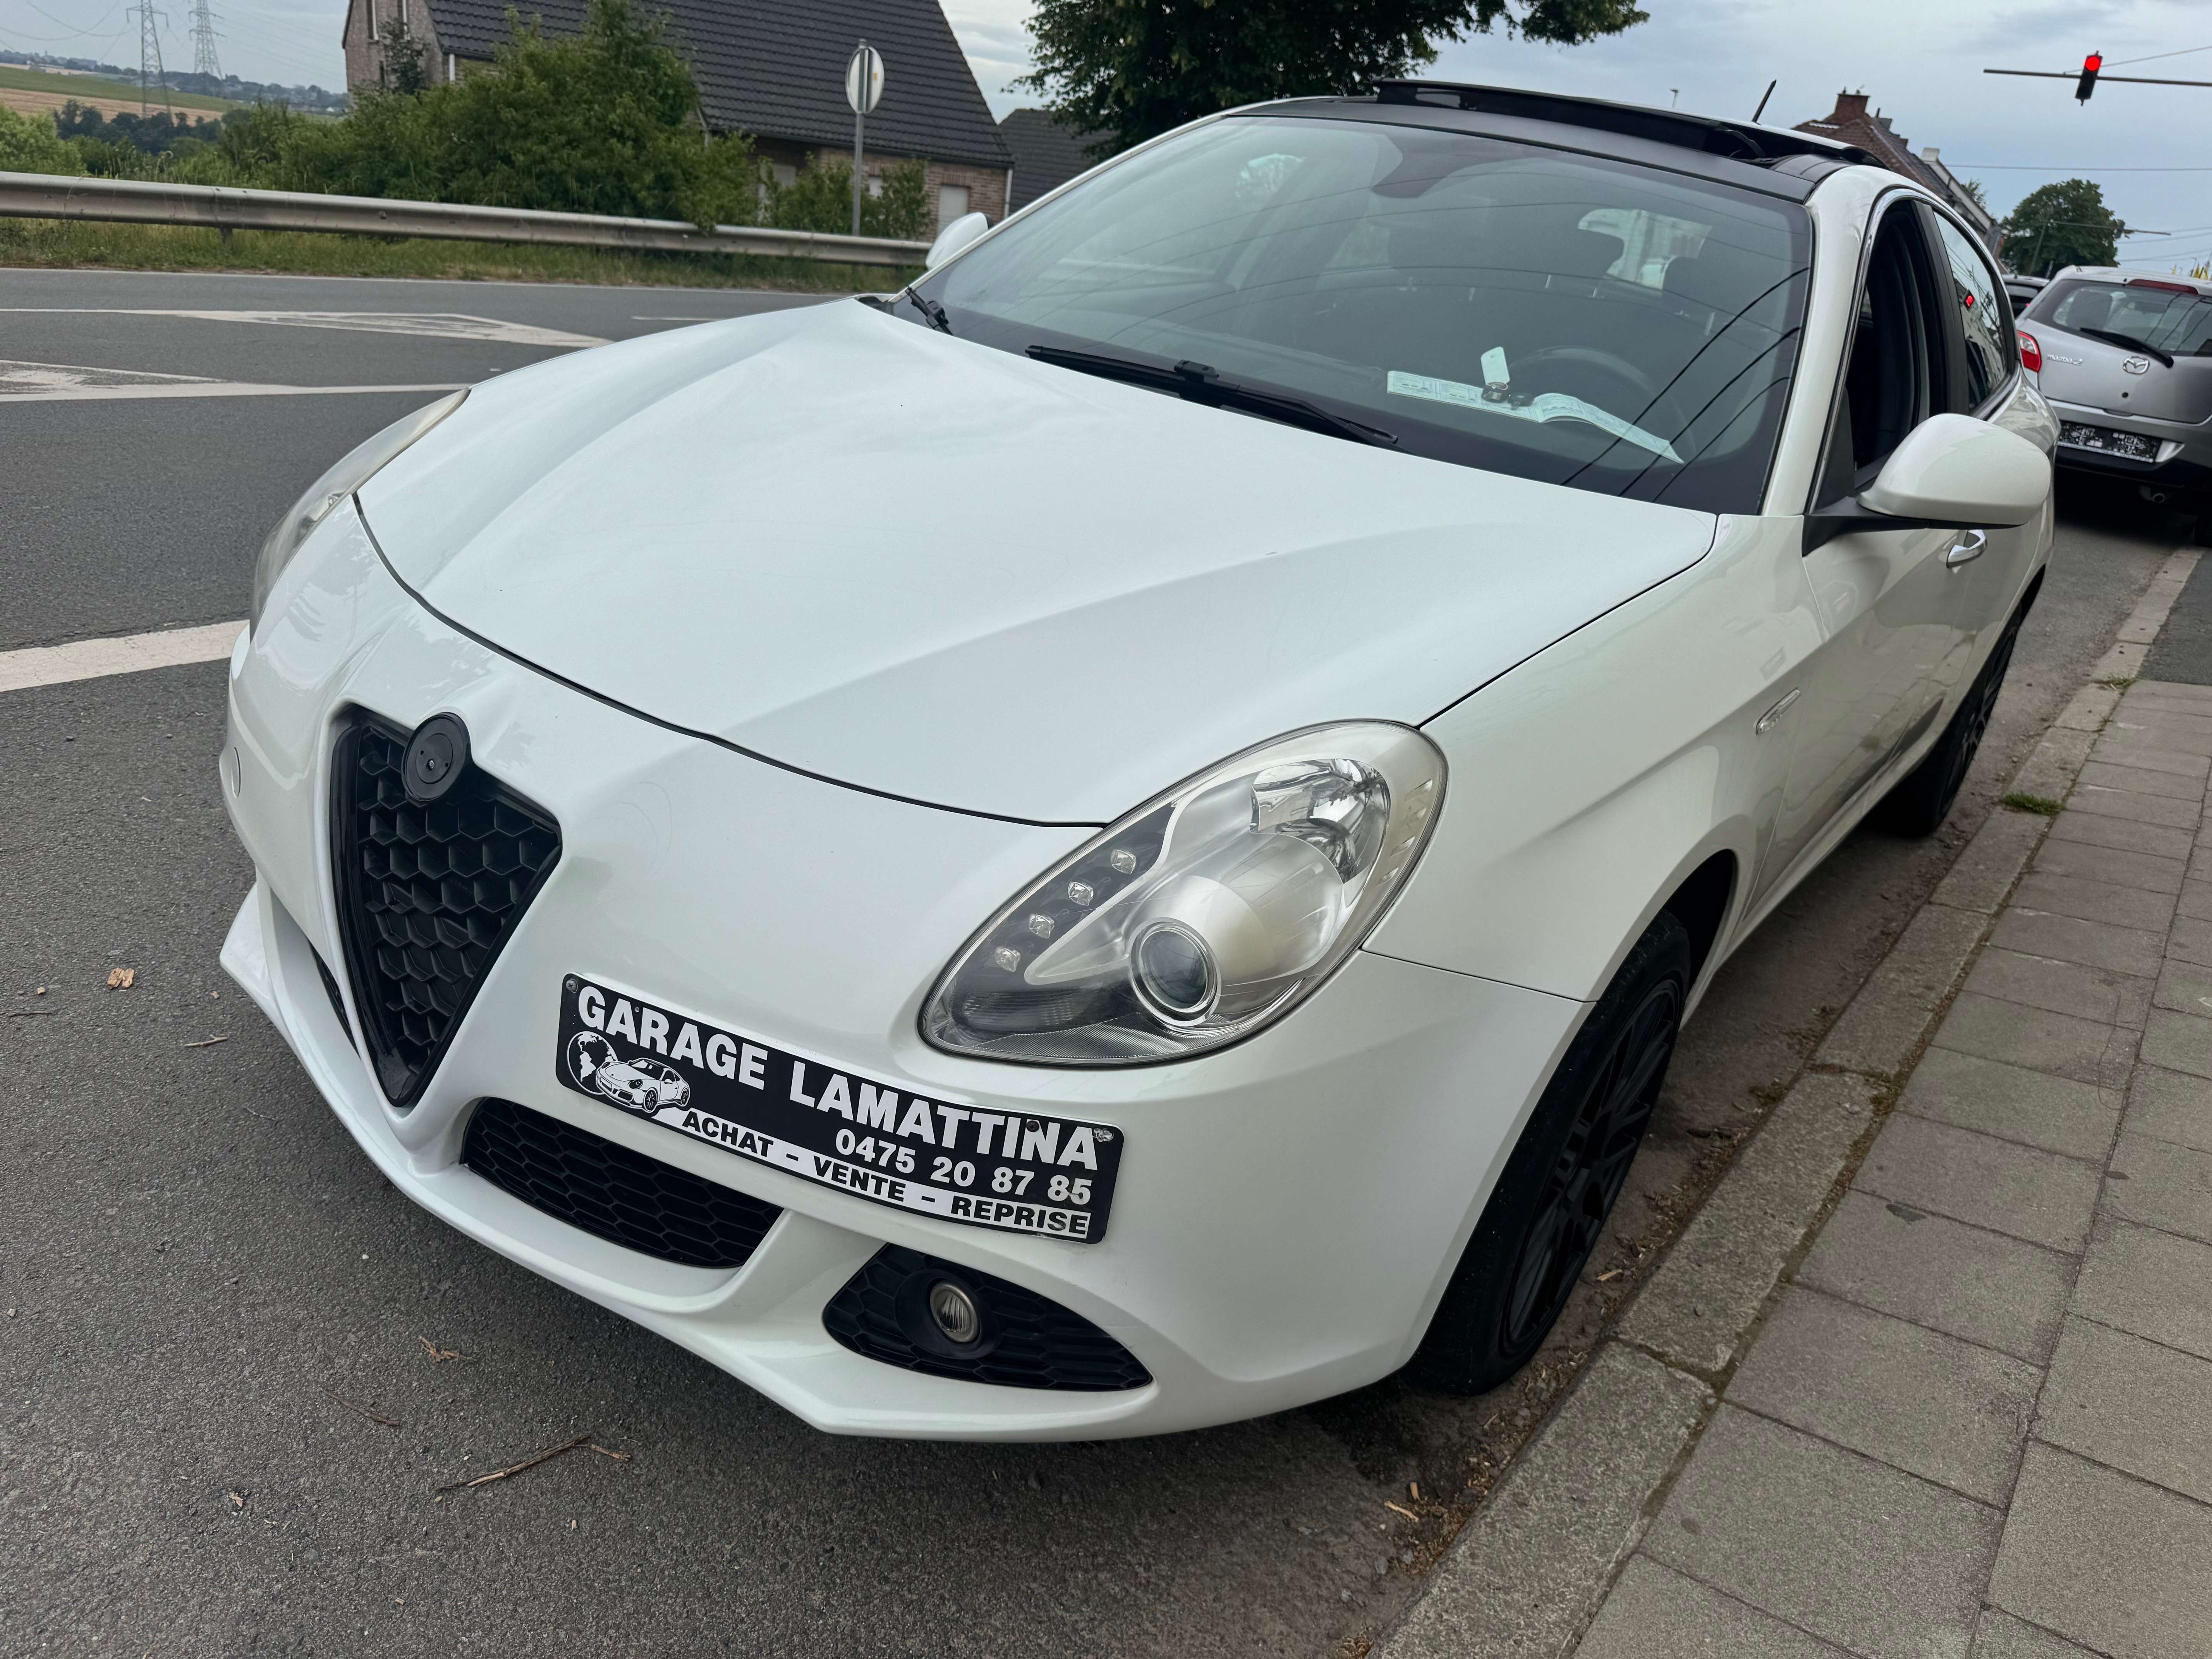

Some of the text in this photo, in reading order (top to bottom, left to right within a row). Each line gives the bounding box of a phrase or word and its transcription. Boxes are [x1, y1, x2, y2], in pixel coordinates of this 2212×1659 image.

[578, 986, 1098, 1171] GARAGE LAMATTINA
[682, 1110, 774, 1158] ACHAT
[813, 1155, 906, 1202] VENTE
[951, 1195, 1088, 1235] REPRISE
[836, 1128, 1092, 1205] 0475 20 87 85
